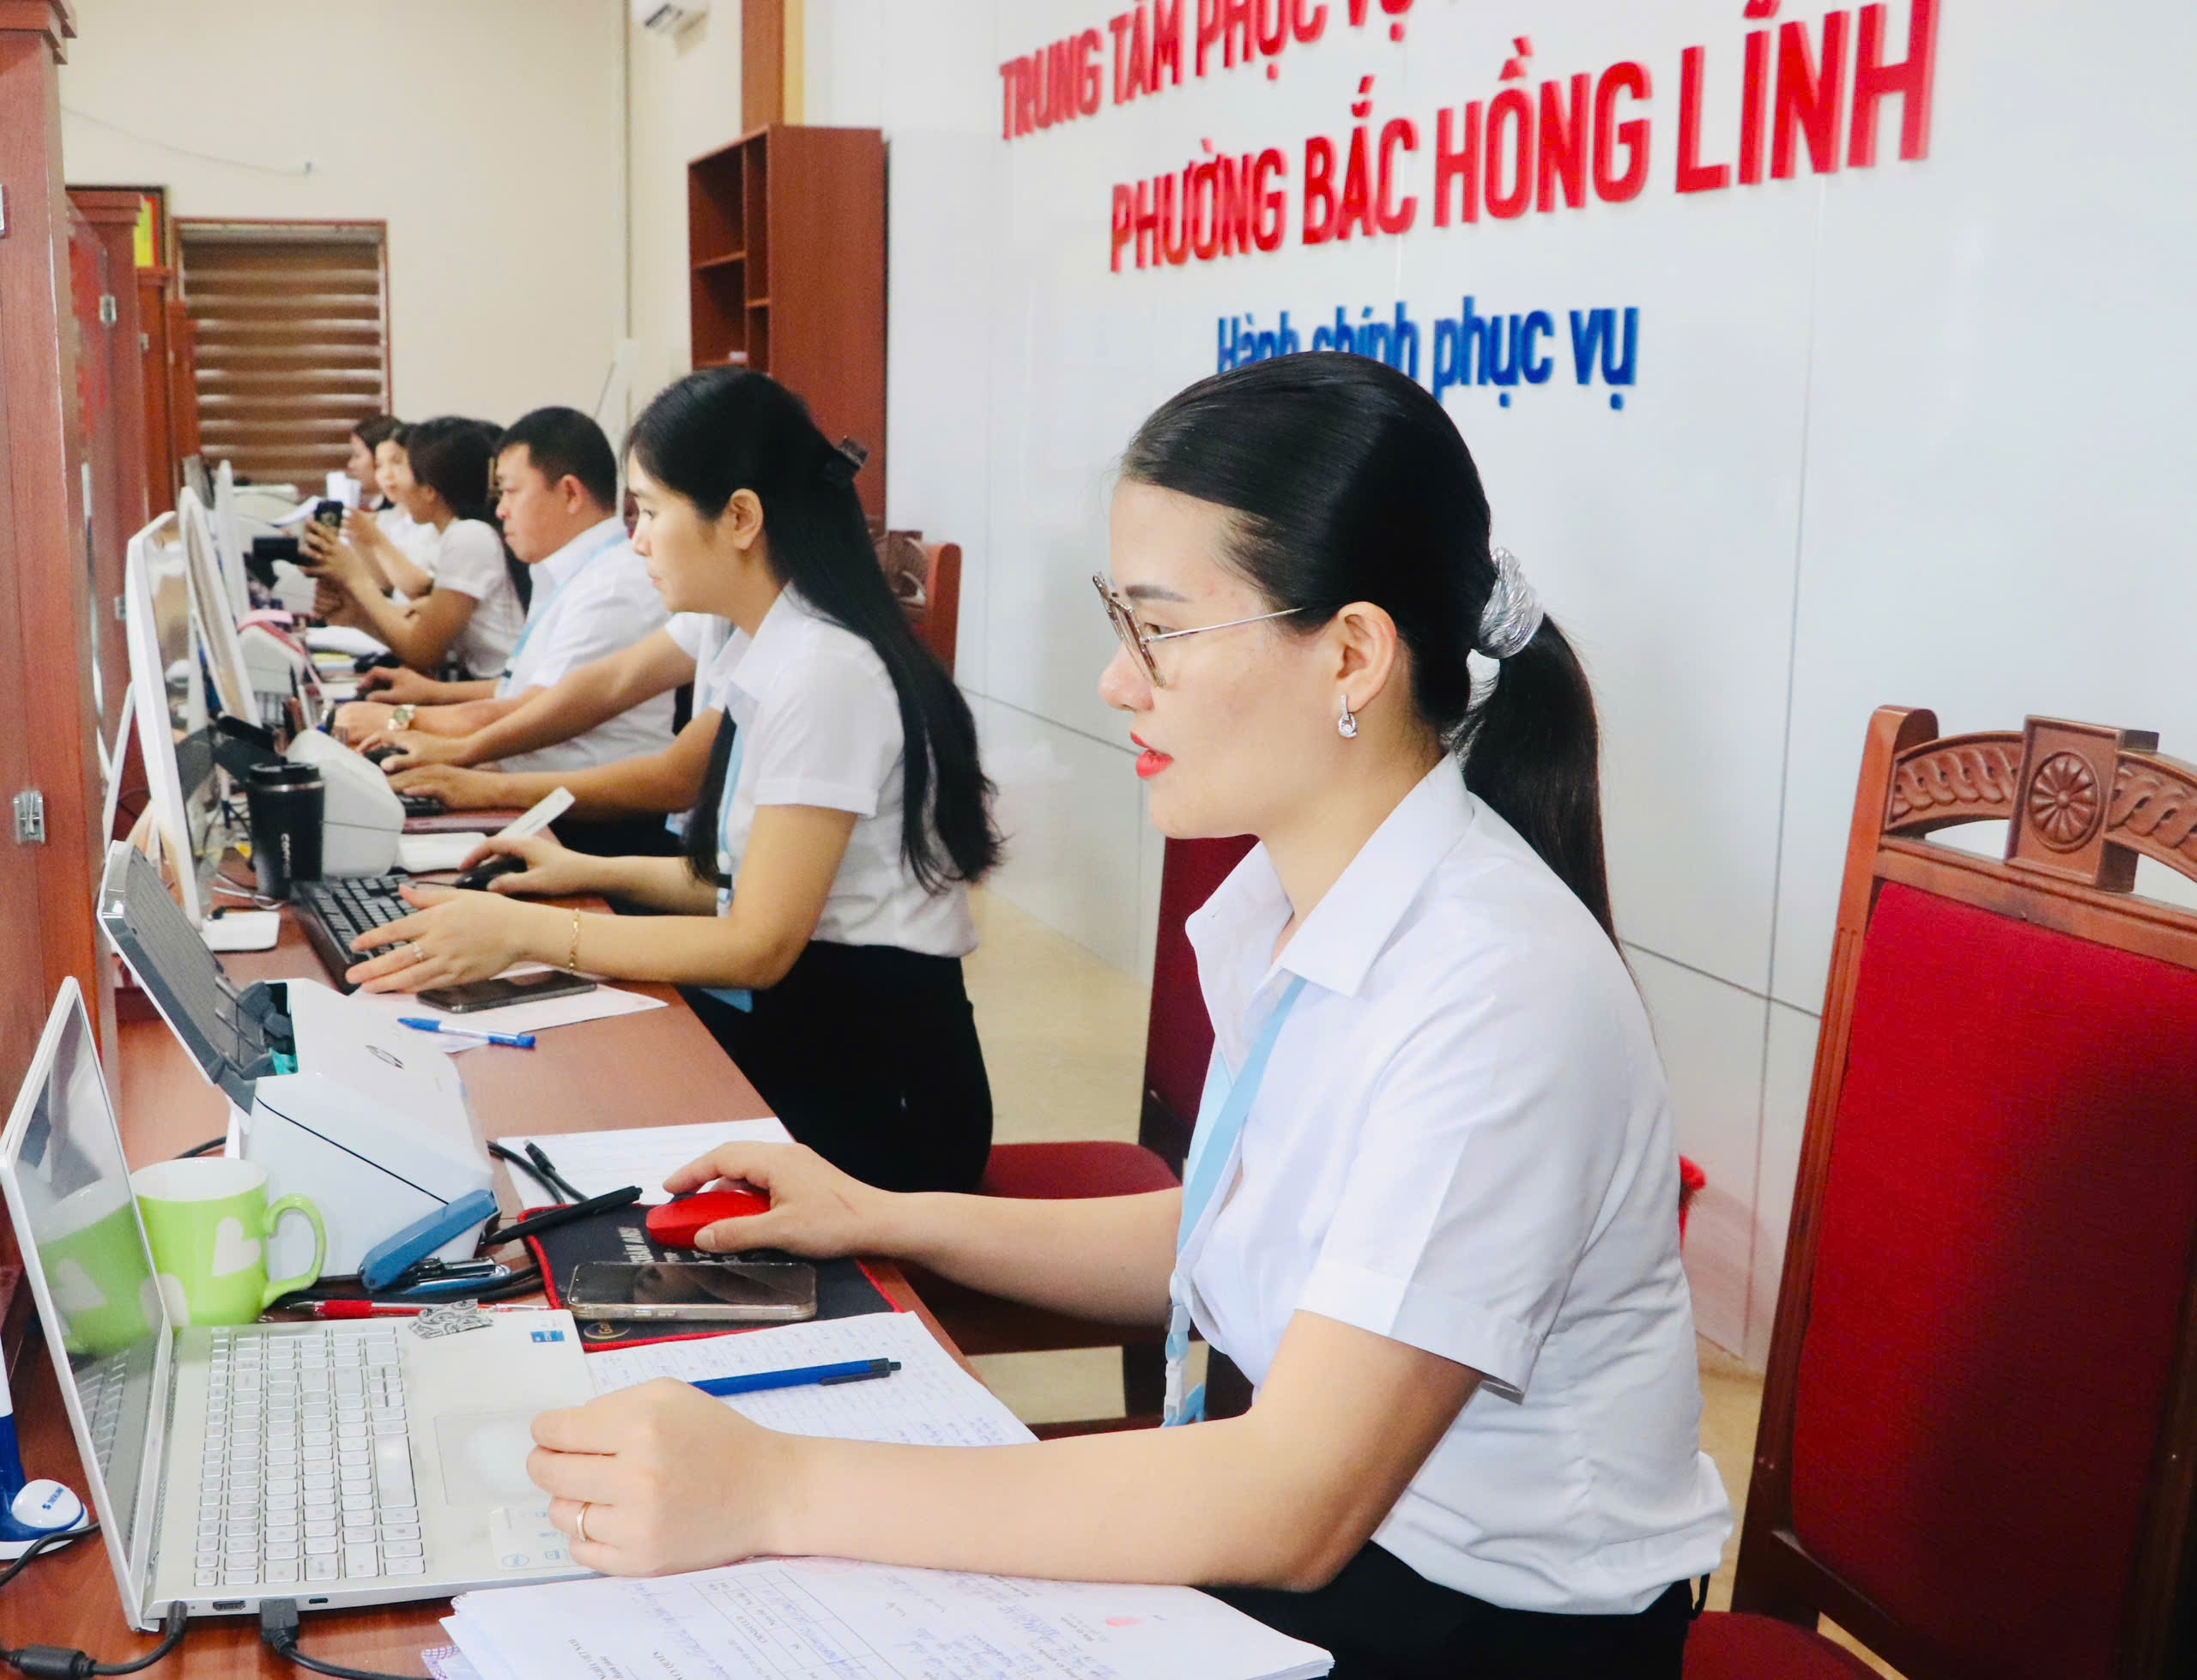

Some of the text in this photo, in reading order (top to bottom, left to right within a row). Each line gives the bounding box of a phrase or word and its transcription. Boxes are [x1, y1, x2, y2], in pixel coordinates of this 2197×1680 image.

[1000, 28, 1104, 141] TRUNG
[1111, 137, 1288, 273] PHƯỜNG
[1302, 75, 1420, 246] BẮC
[1434, 35, 1652, 228] HỒNG
[1432, 295, 1556, 408] phục
[1569, 305, 1640, 412] vụ
